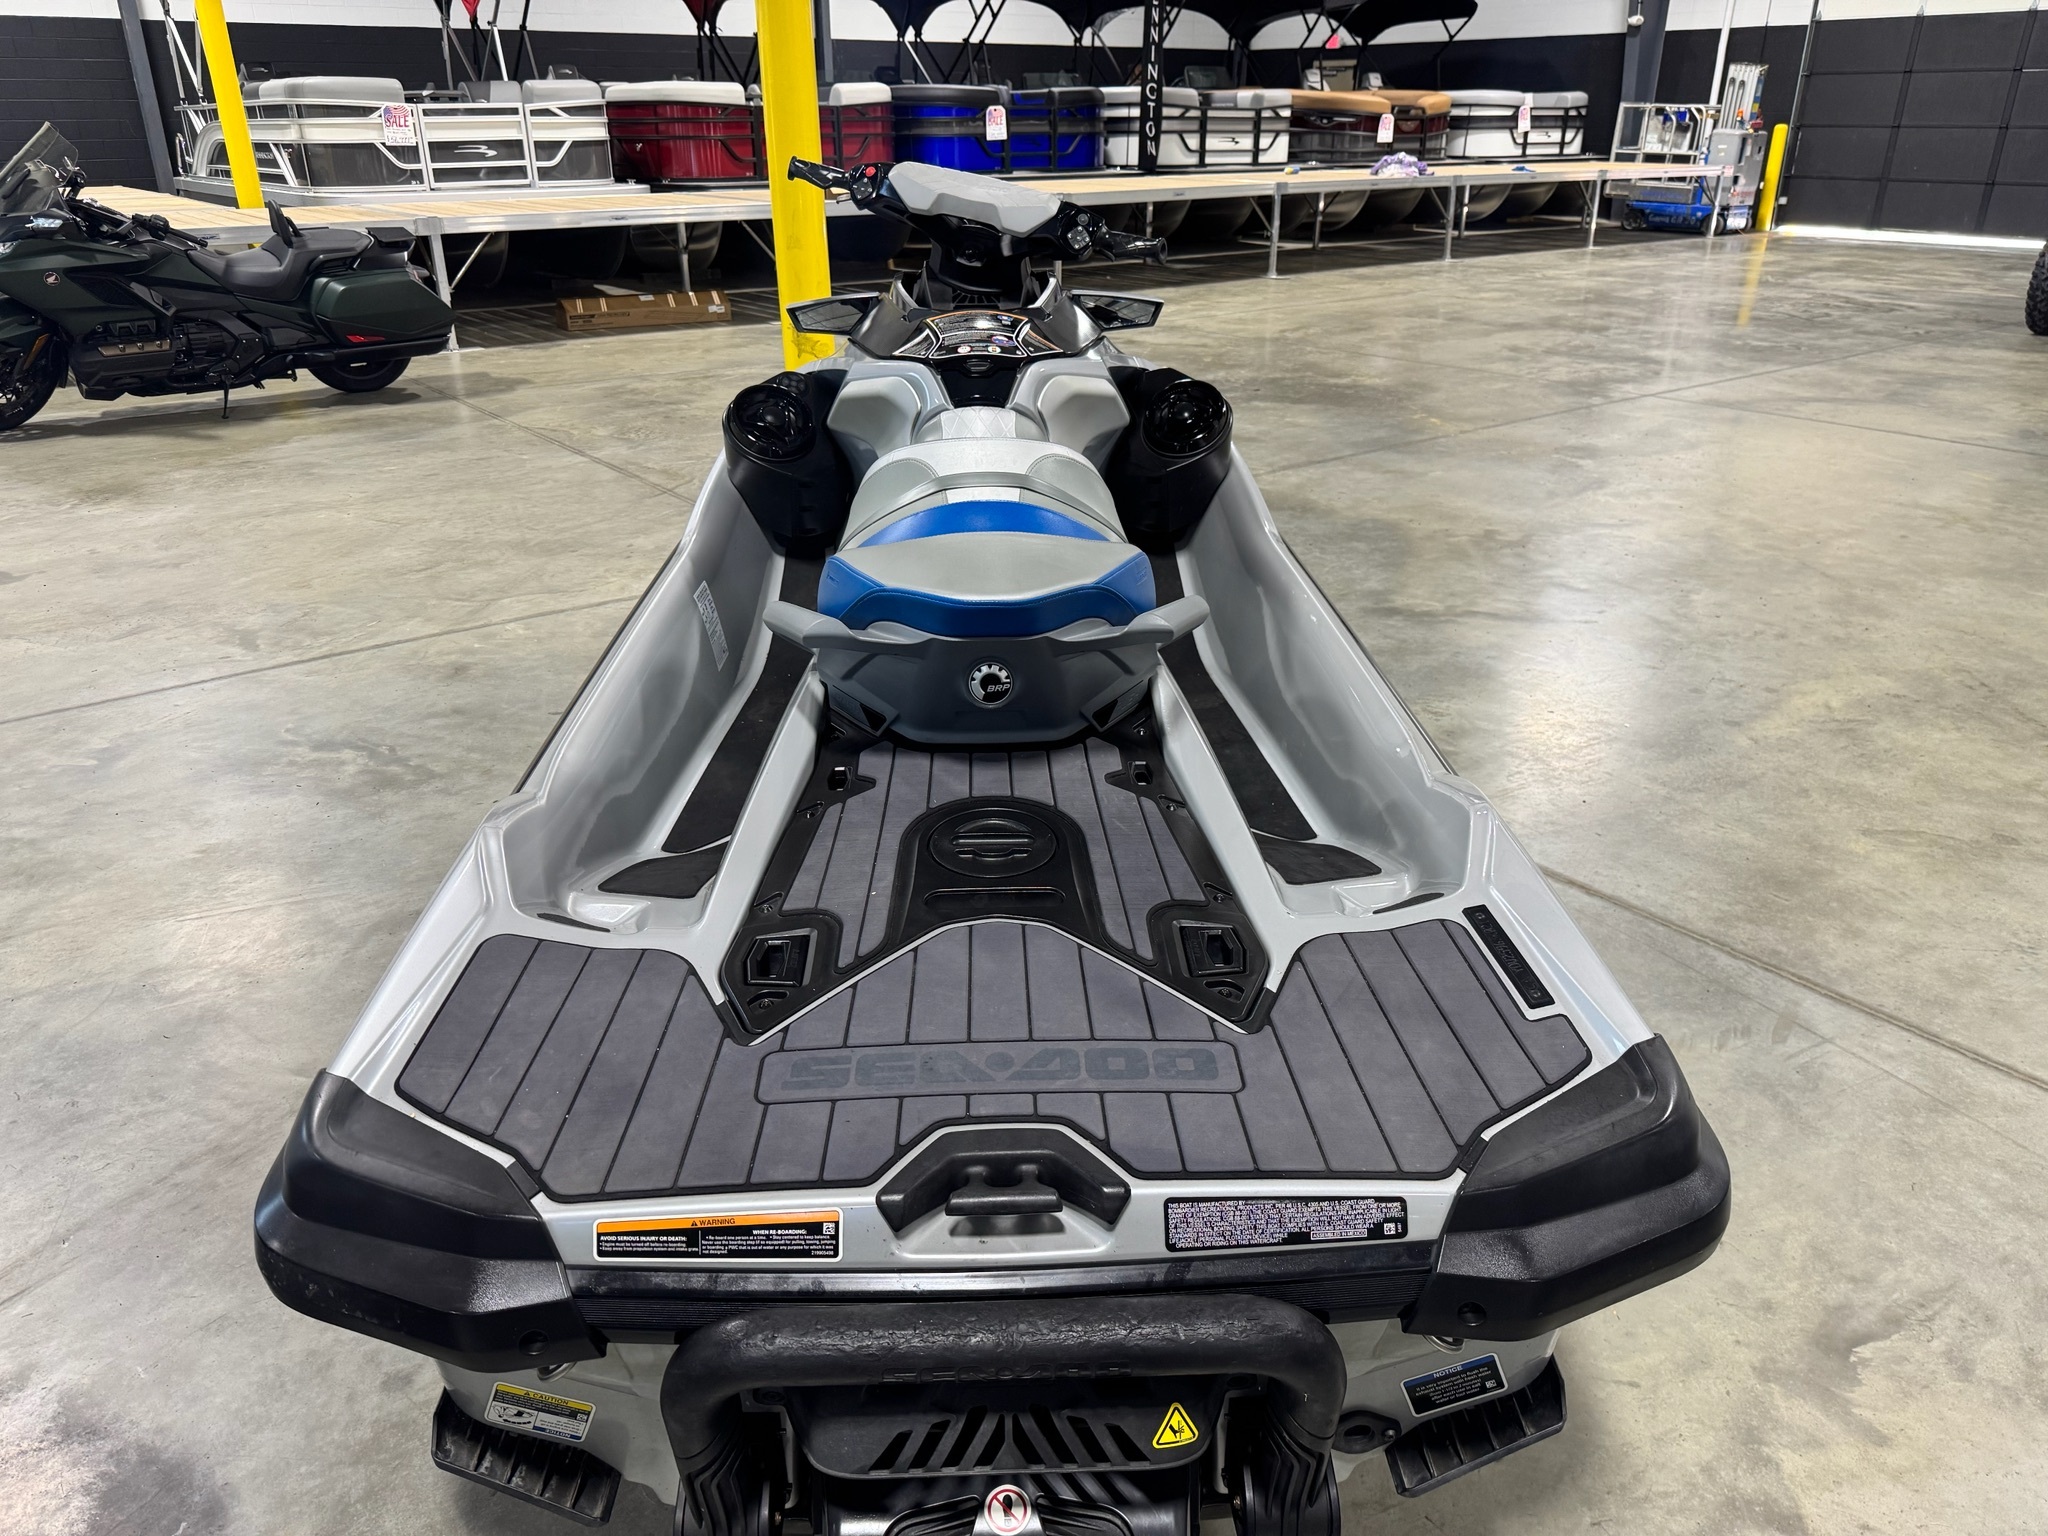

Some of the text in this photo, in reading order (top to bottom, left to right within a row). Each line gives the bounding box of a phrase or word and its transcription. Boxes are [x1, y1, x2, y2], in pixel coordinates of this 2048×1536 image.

[1145, 0, 1159, 157] NNINGTON
[385, 114, 410, 128] SALE
[987, 684, 1010, 692] BRP
[699, 1218, 736, 1226] WARNING
[1433, 1365, 1463, 1378] NOTICE
[533, 1393, 569, 1406] CAUTION
